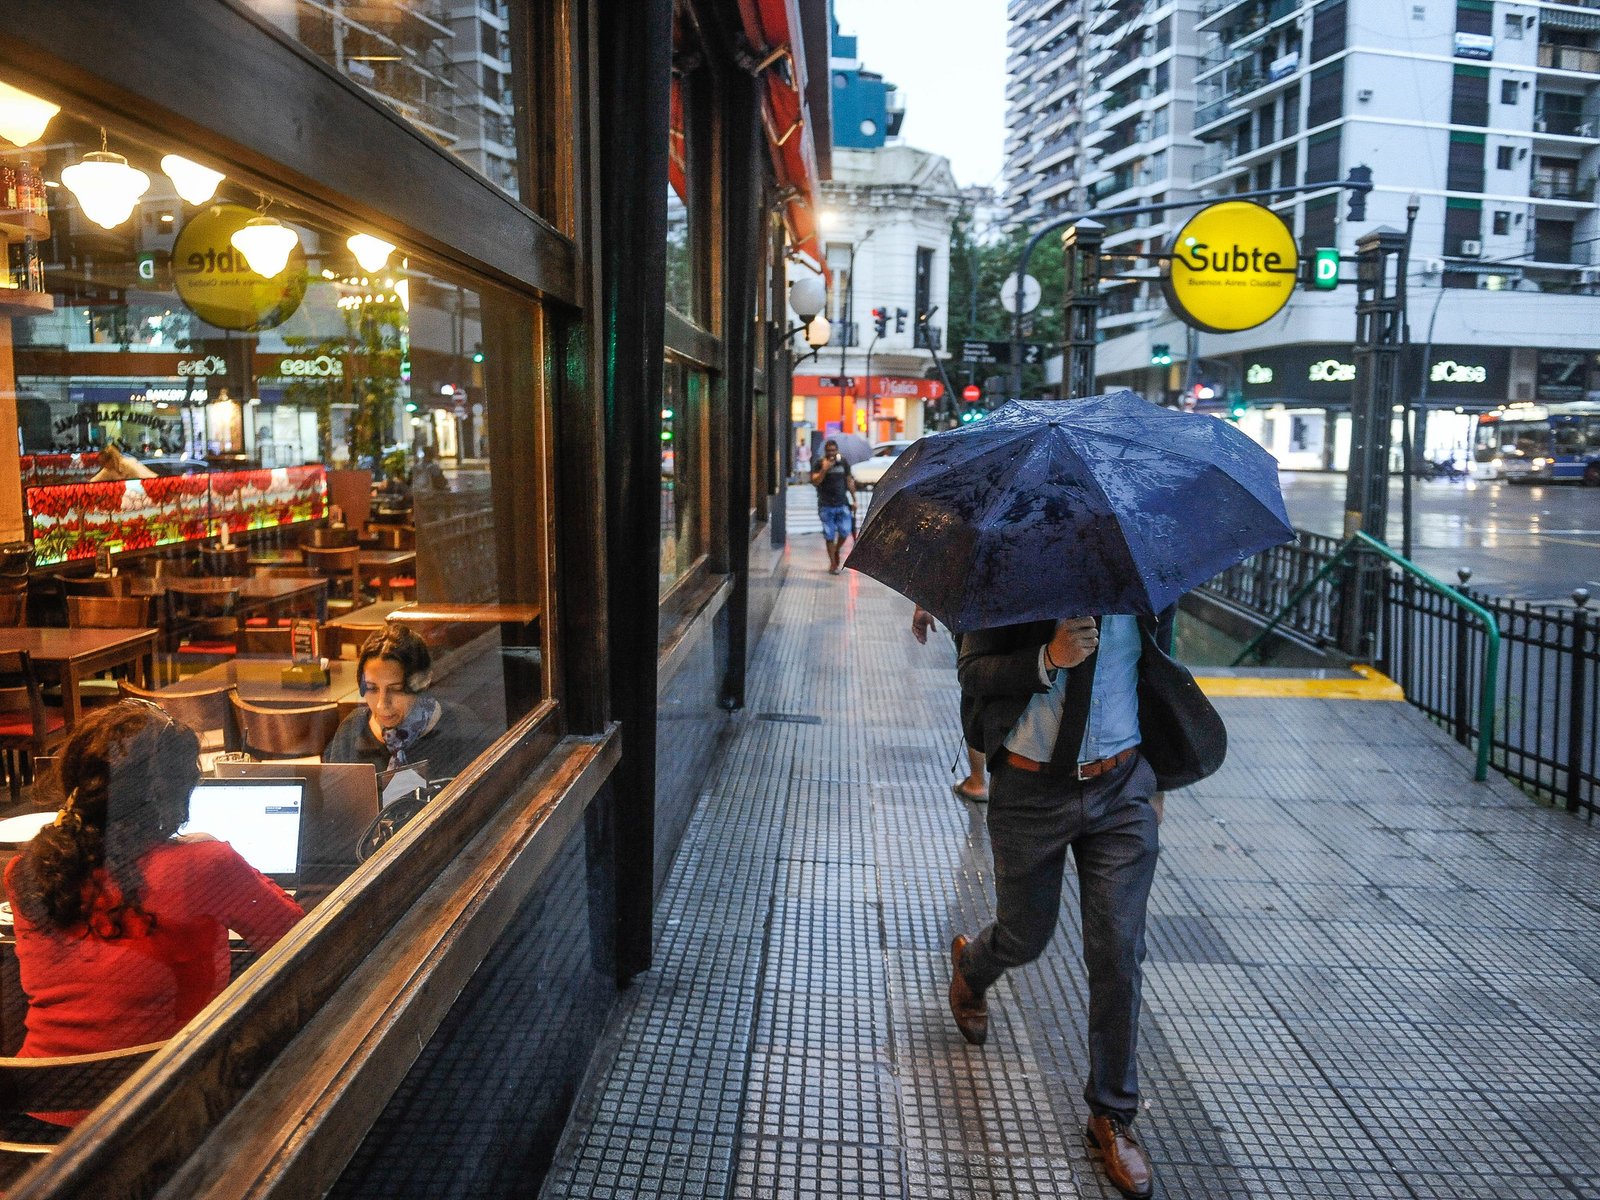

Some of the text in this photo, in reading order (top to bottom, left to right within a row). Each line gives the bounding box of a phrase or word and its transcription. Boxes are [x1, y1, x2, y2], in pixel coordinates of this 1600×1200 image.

[1188, 243, 1285, 273] Subte
[1317, 258, 1337, 280] D
[1225, 277, 1247, 287] Aires
[1250, 278, 1282, 288] Ciudad
